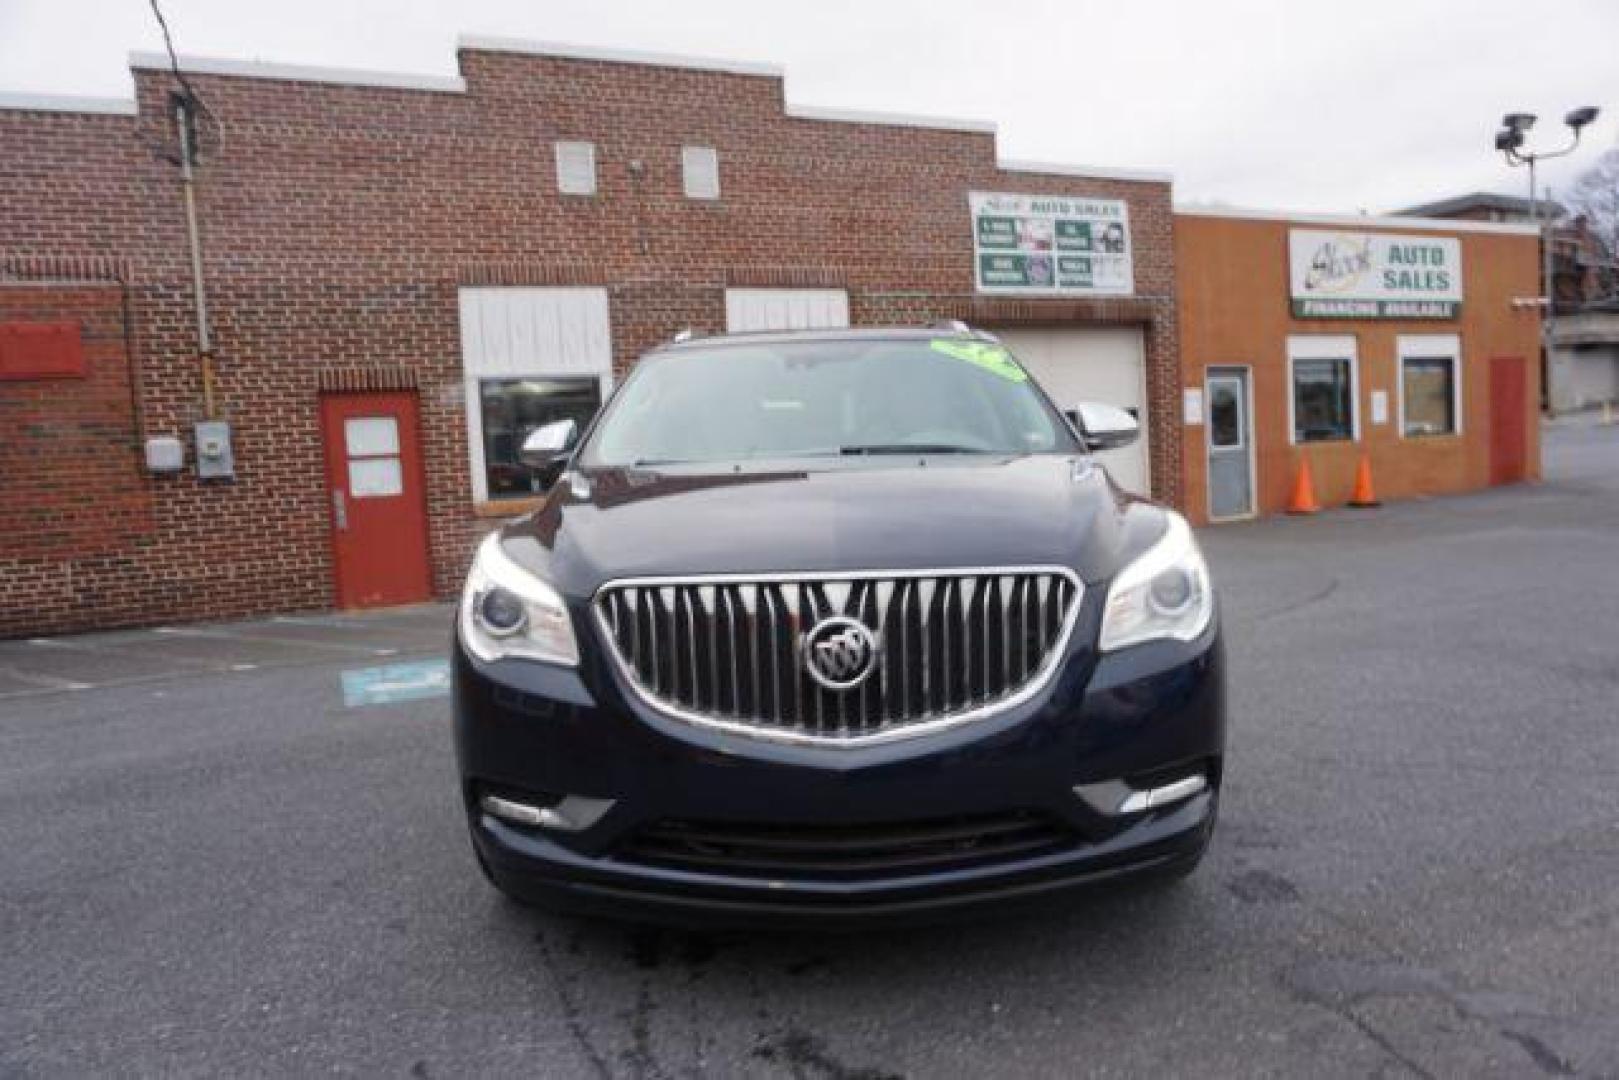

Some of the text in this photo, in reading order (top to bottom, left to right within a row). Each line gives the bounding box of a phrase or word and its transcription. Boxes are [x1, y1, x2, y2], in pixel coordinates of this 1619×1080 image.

[1031, 201, 1071, 214] AUTO
[1075, 203, 1120, 216] SALES
[1388, 244, 1445, 266] AUTO
[1383, 269, 1450, 290] SALES
[1303, 301, 1452, 317] FINANCING AVAILABLE
